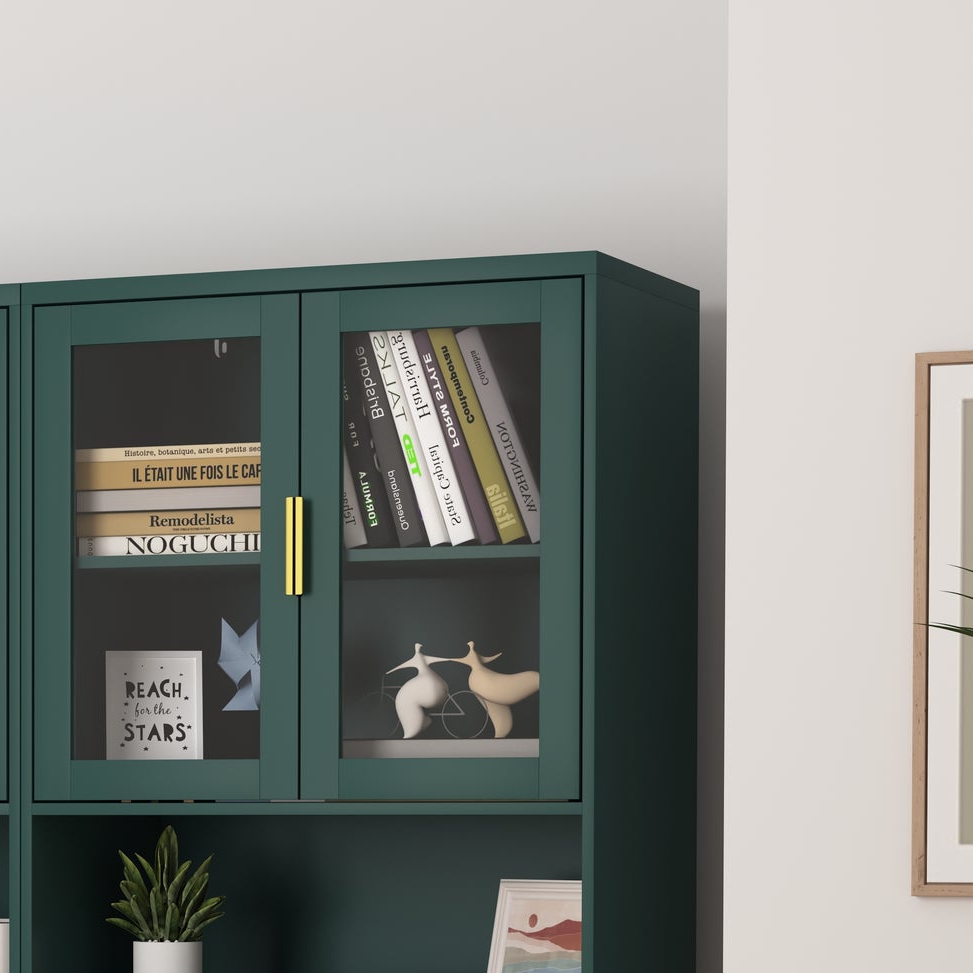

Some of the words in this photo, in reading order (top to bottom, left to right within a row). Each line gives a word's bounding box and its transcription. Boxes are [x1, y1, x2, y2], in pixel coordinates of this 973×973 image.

[158, 447, 196, 456] botanique,
[225, 445, 246, 454] petits
[133, 468, 142, 482] IL
[145, 465, 174, 482] ÉTAIT
[177, 465, 197, 481] UNE
[200, 464, 223, 479] FOIS
[226, 464, 238, 478] LE
[149, 513, 234, 527] Remodelista
[126, 534, 259, 554] NOGUCHI
[126, 679, 181, 699] REACH
[135, 702, 151, 717] for
[154, 702, 171, 715] the
[124, 723, 186, 742] STARS
